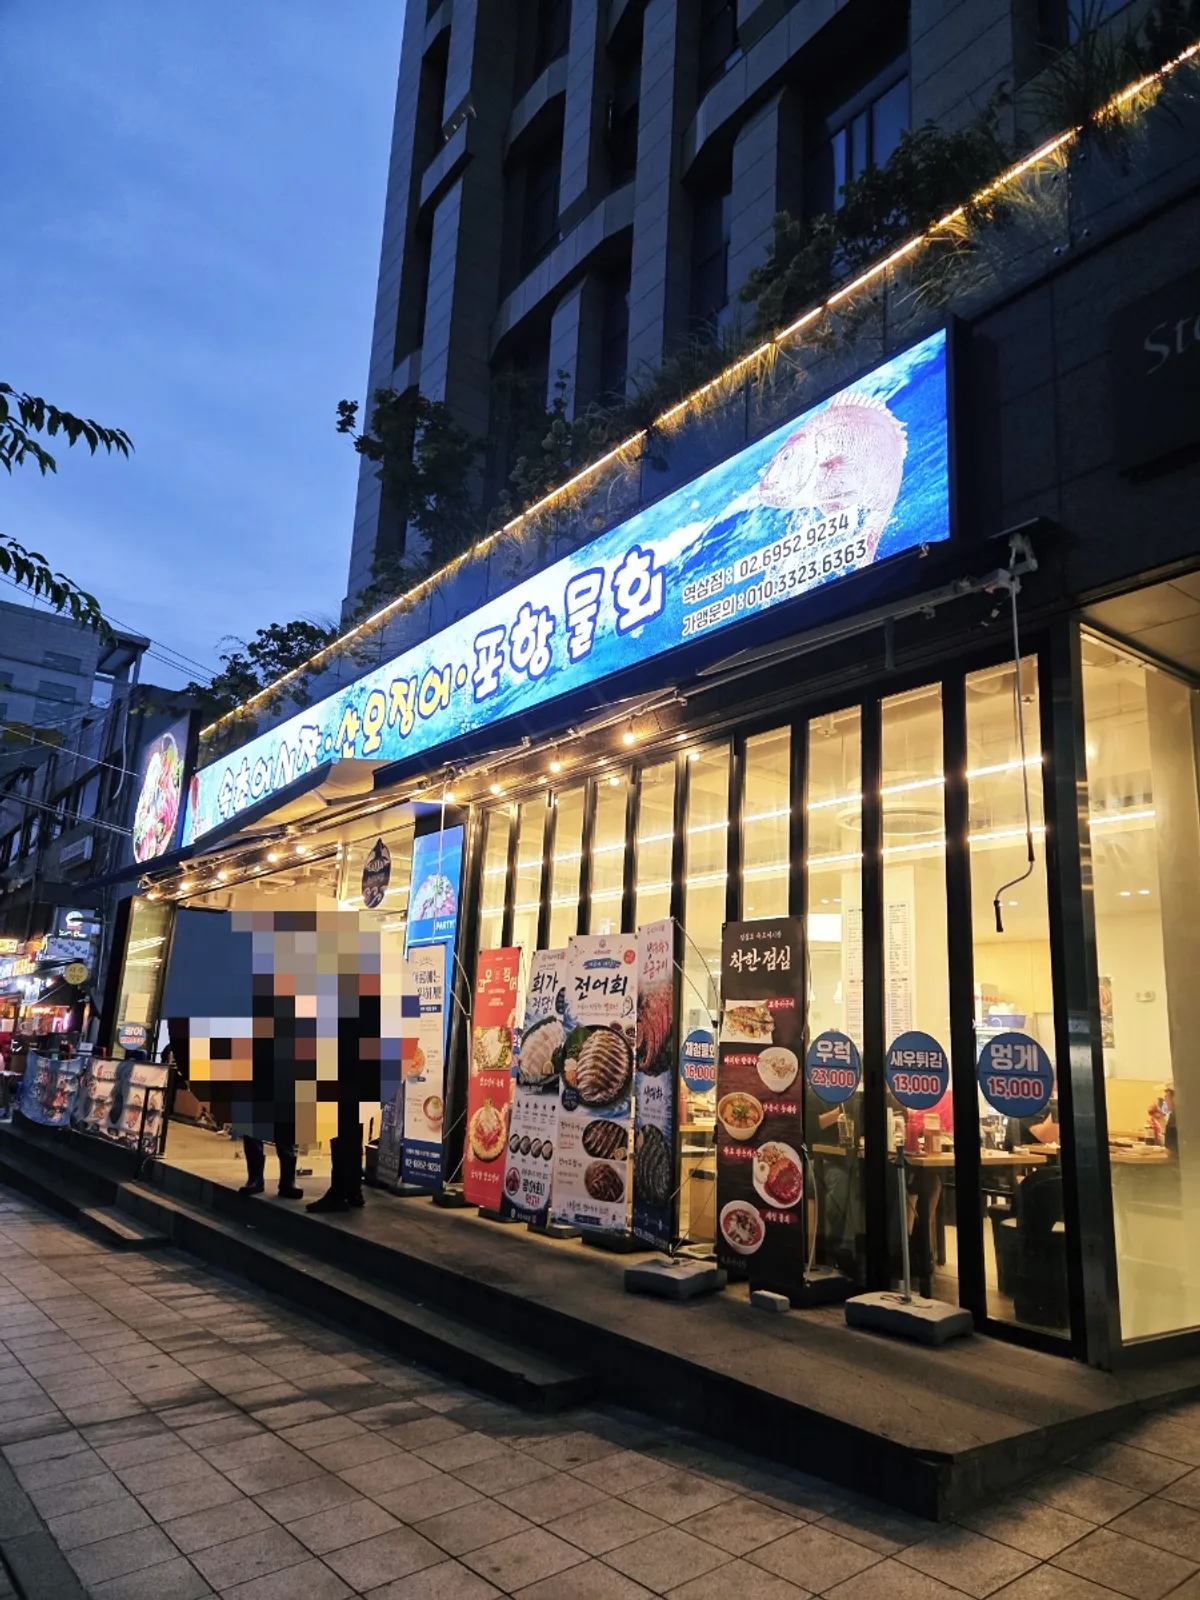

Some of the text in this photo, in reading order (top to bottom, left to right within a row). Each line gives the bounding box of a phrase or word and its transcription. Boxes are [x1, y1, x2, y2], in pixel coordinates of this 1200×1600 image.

[739, 513, 850, 578] 02.6952.9234
[747, 538, 867, 606] 010.3323.6363
[729, 945, 791, 973] 착한 점심
[531, 971, 558, 994] 회가
[575, 973, 628, 1001] 전어회
[816, 1039, 851, 1064] 우럭
[890, 1051, 943, 1069] 새우튀김
[990, 1043, 1039, 1072] 멍게
[685, 1063, 716, 1080] 16,000
[811, 1068, 855, 1088] 23,000
[893, 1074, 940, 1095] 13,000
[988, 1077, 1043, 1099] 15,000
